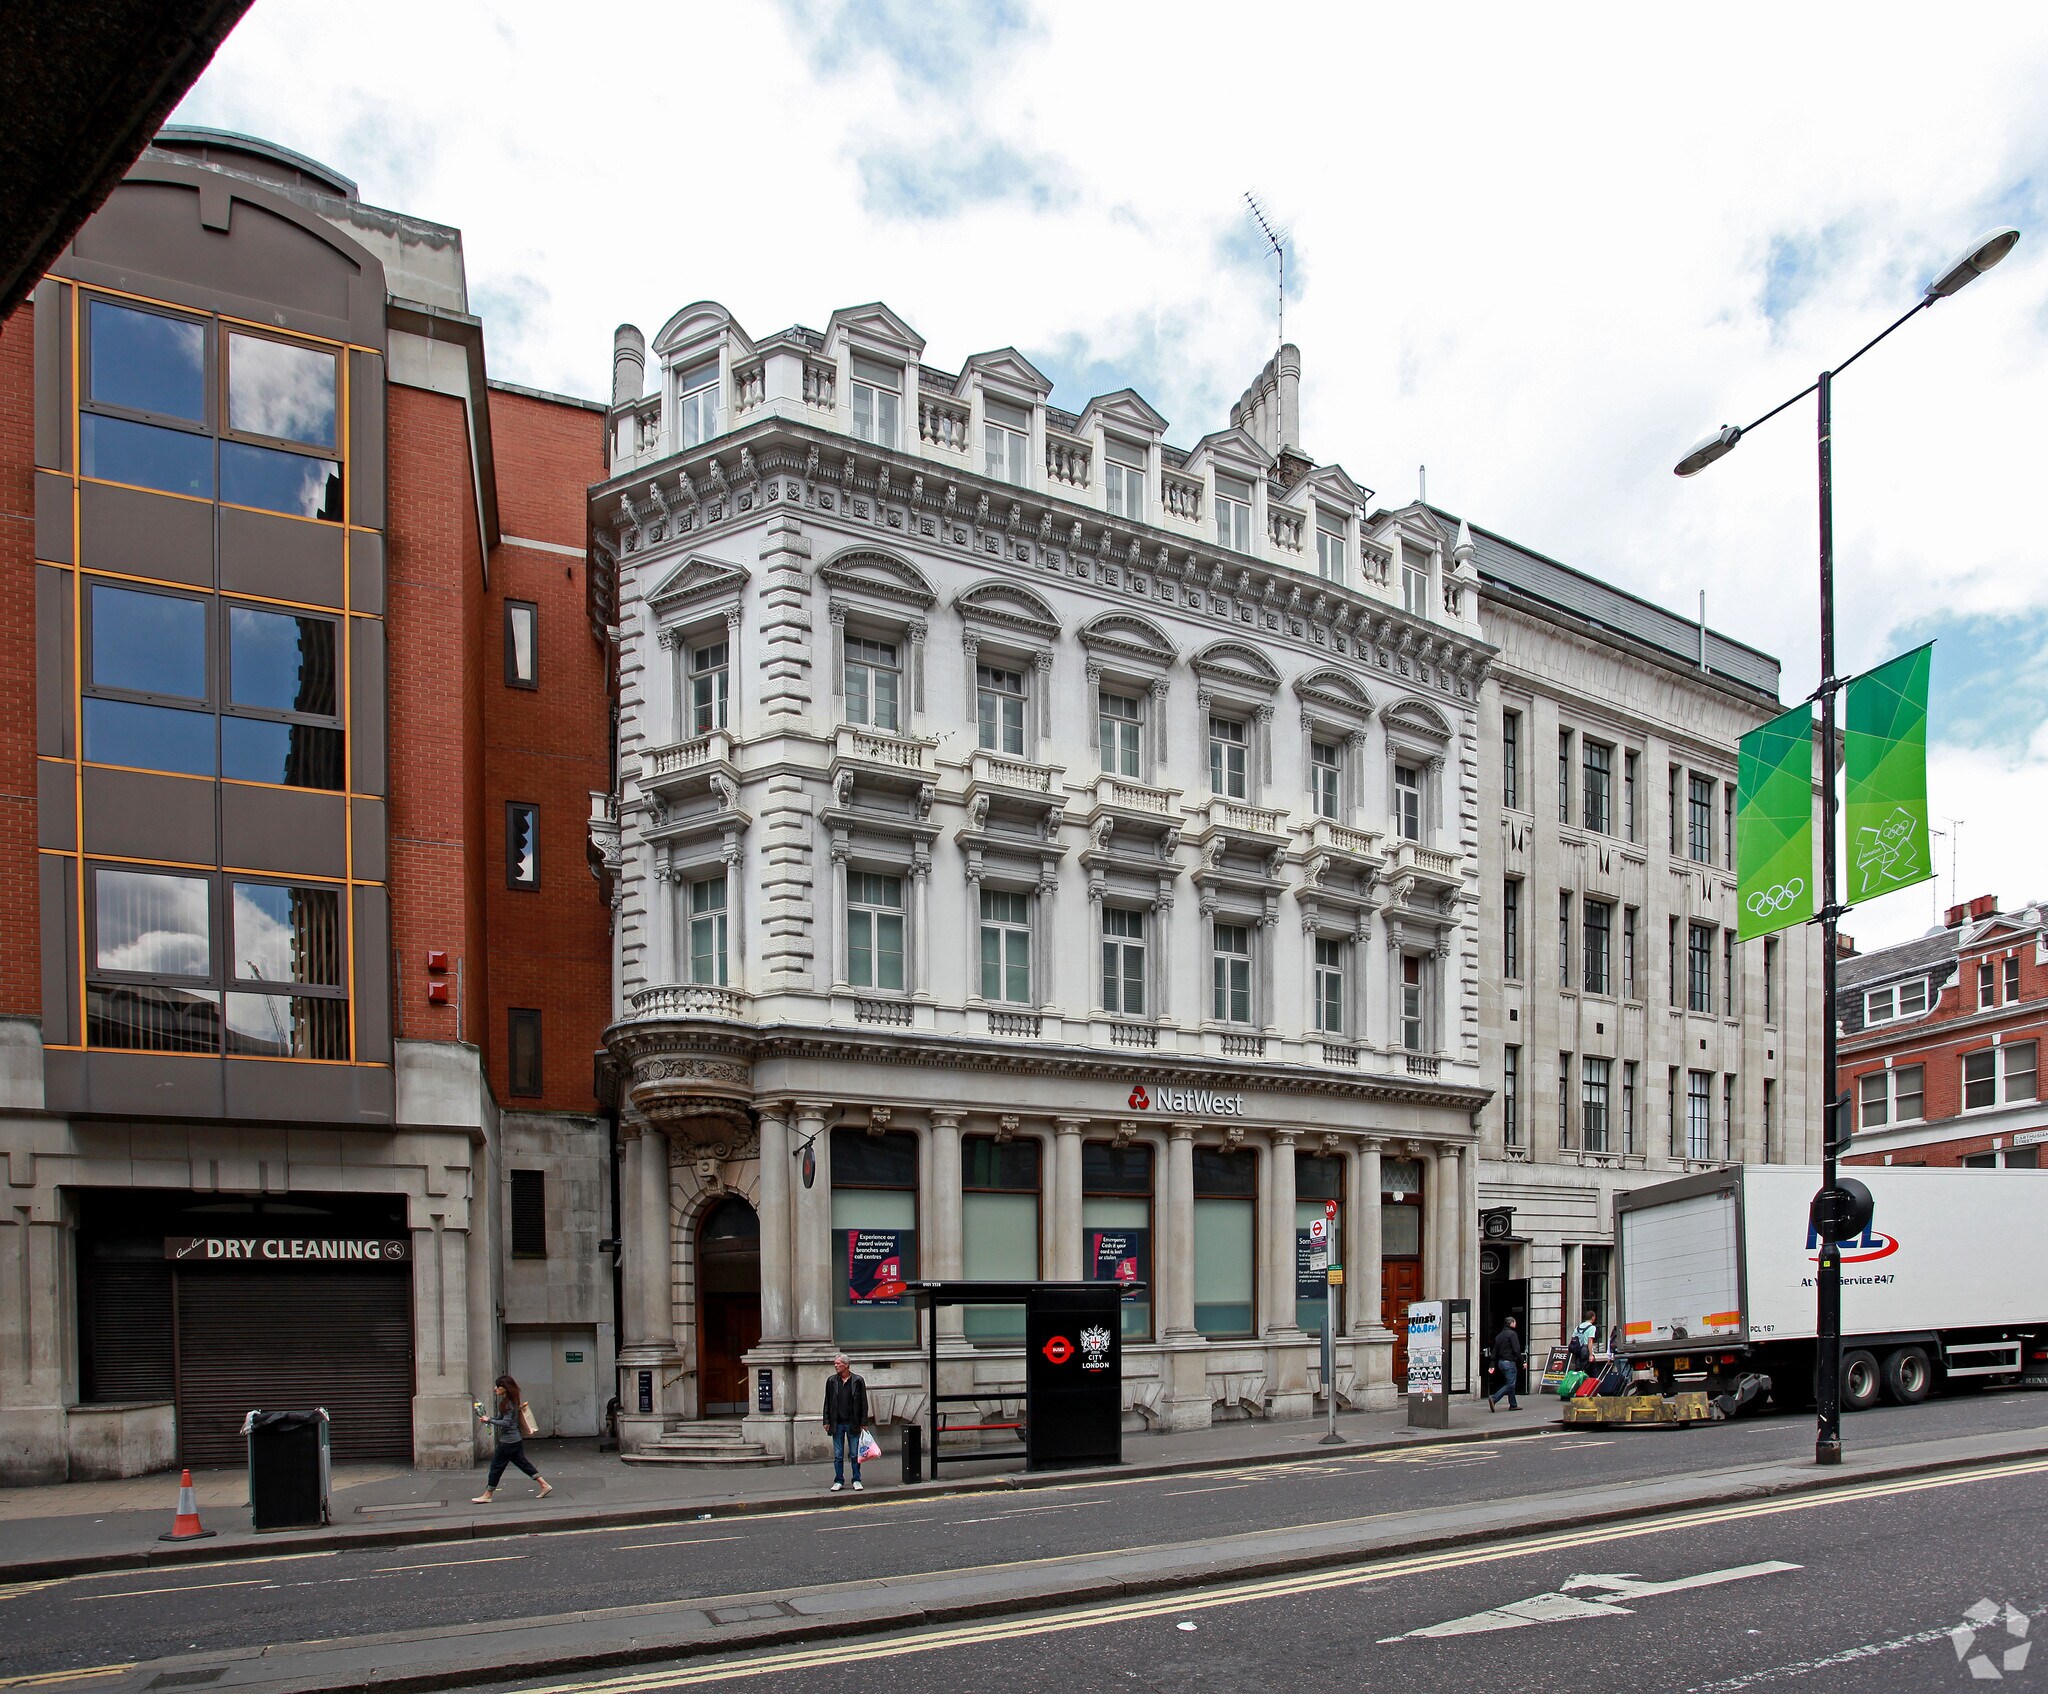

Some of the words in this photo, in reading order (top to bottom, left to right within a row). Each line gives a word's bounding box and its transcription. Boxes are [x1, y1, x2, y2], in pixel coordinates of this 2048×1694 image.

[1156, 1087, 1244, 1115] NatWest
[1490, 1224, 1503, 1234] HILL
[207, 1239, 256, 1258] DRY
[262, 1240, 380, 1259] CLEANING
[1481, 1262, 1494, 1270] HILL
[1801, 1278, 1812, 1287] At
[1874, 1274, 1895, 1285] 24/7
[1764, 1324, 1775, 1332] 167
[1552, 1352, 1568, 1360] FREE
